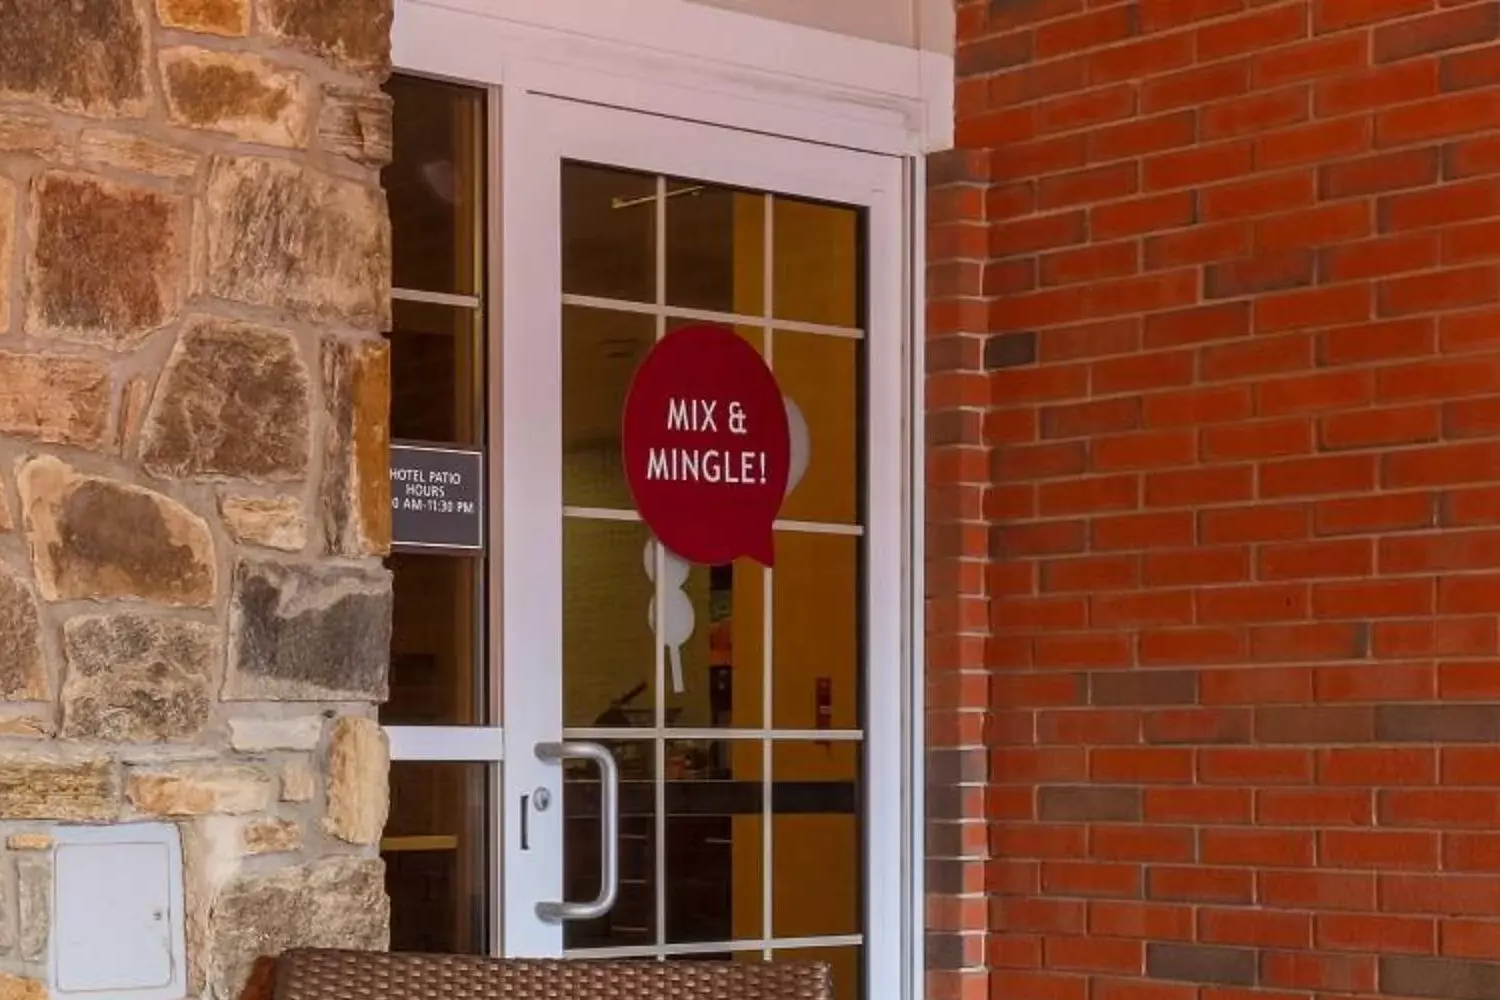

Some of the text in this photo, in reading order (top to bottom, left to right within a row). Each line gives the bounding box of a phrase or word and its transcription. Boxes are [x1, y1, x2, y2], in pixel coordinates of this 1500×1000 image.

[666, 397, 748, 434] MIX &
[646, 447, 767, 485] MINGLE!
[389, 468, 461, 485] HOTEL PATIO
[405, 484, 445, 498] HOURS
[457, 500, 474, 514] PM
